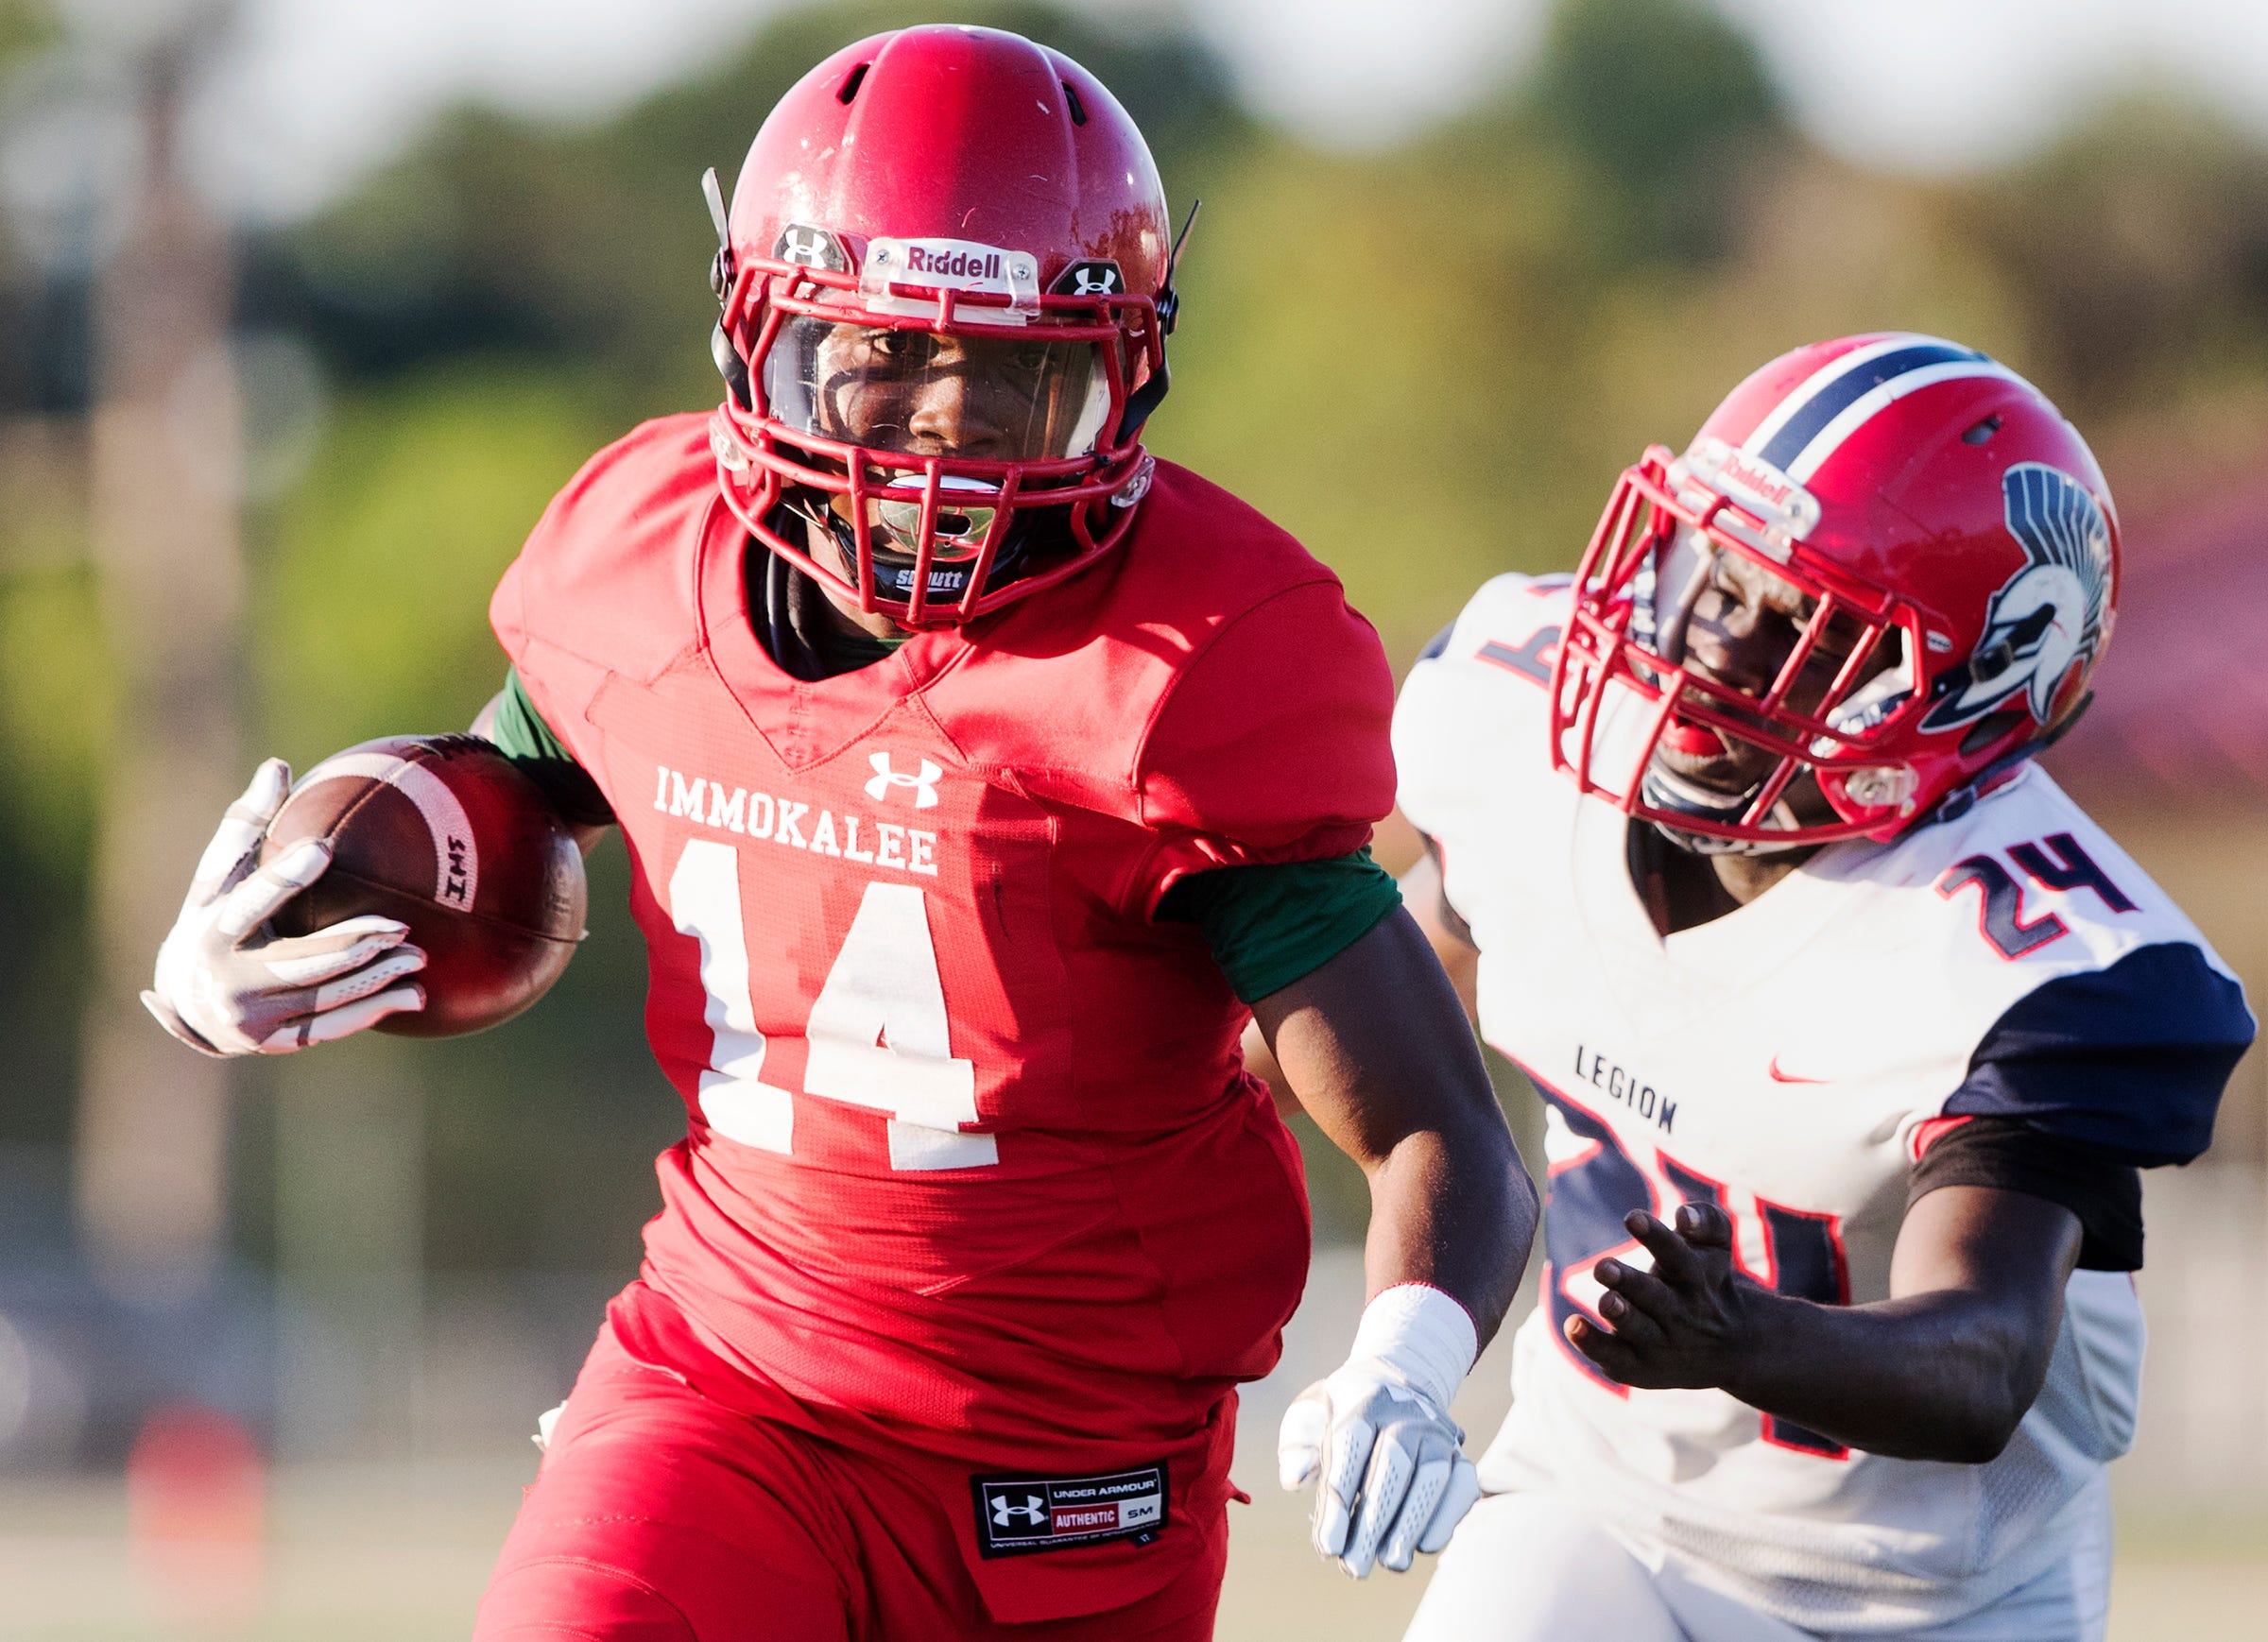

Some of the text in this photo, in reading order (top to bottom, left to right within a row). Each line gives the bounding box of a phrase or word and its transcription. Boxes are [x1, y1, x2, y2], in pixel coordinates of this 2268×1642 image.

[907, 246, 1001, 279] Riddell
[654, 765, 938, 877] IMMOKALEE
[1933, 832, 2142, 962] 24
[669, 838, 999, 1171] 14
[1575, 1044, 1677, 1135] LEGION
[1054, 1480, 1155, 1499] UNDER ARMOUR
[1056, 1510, 1115, 1529] AUTHENTIC
[1127, 1506, 1154, 1519] SM
